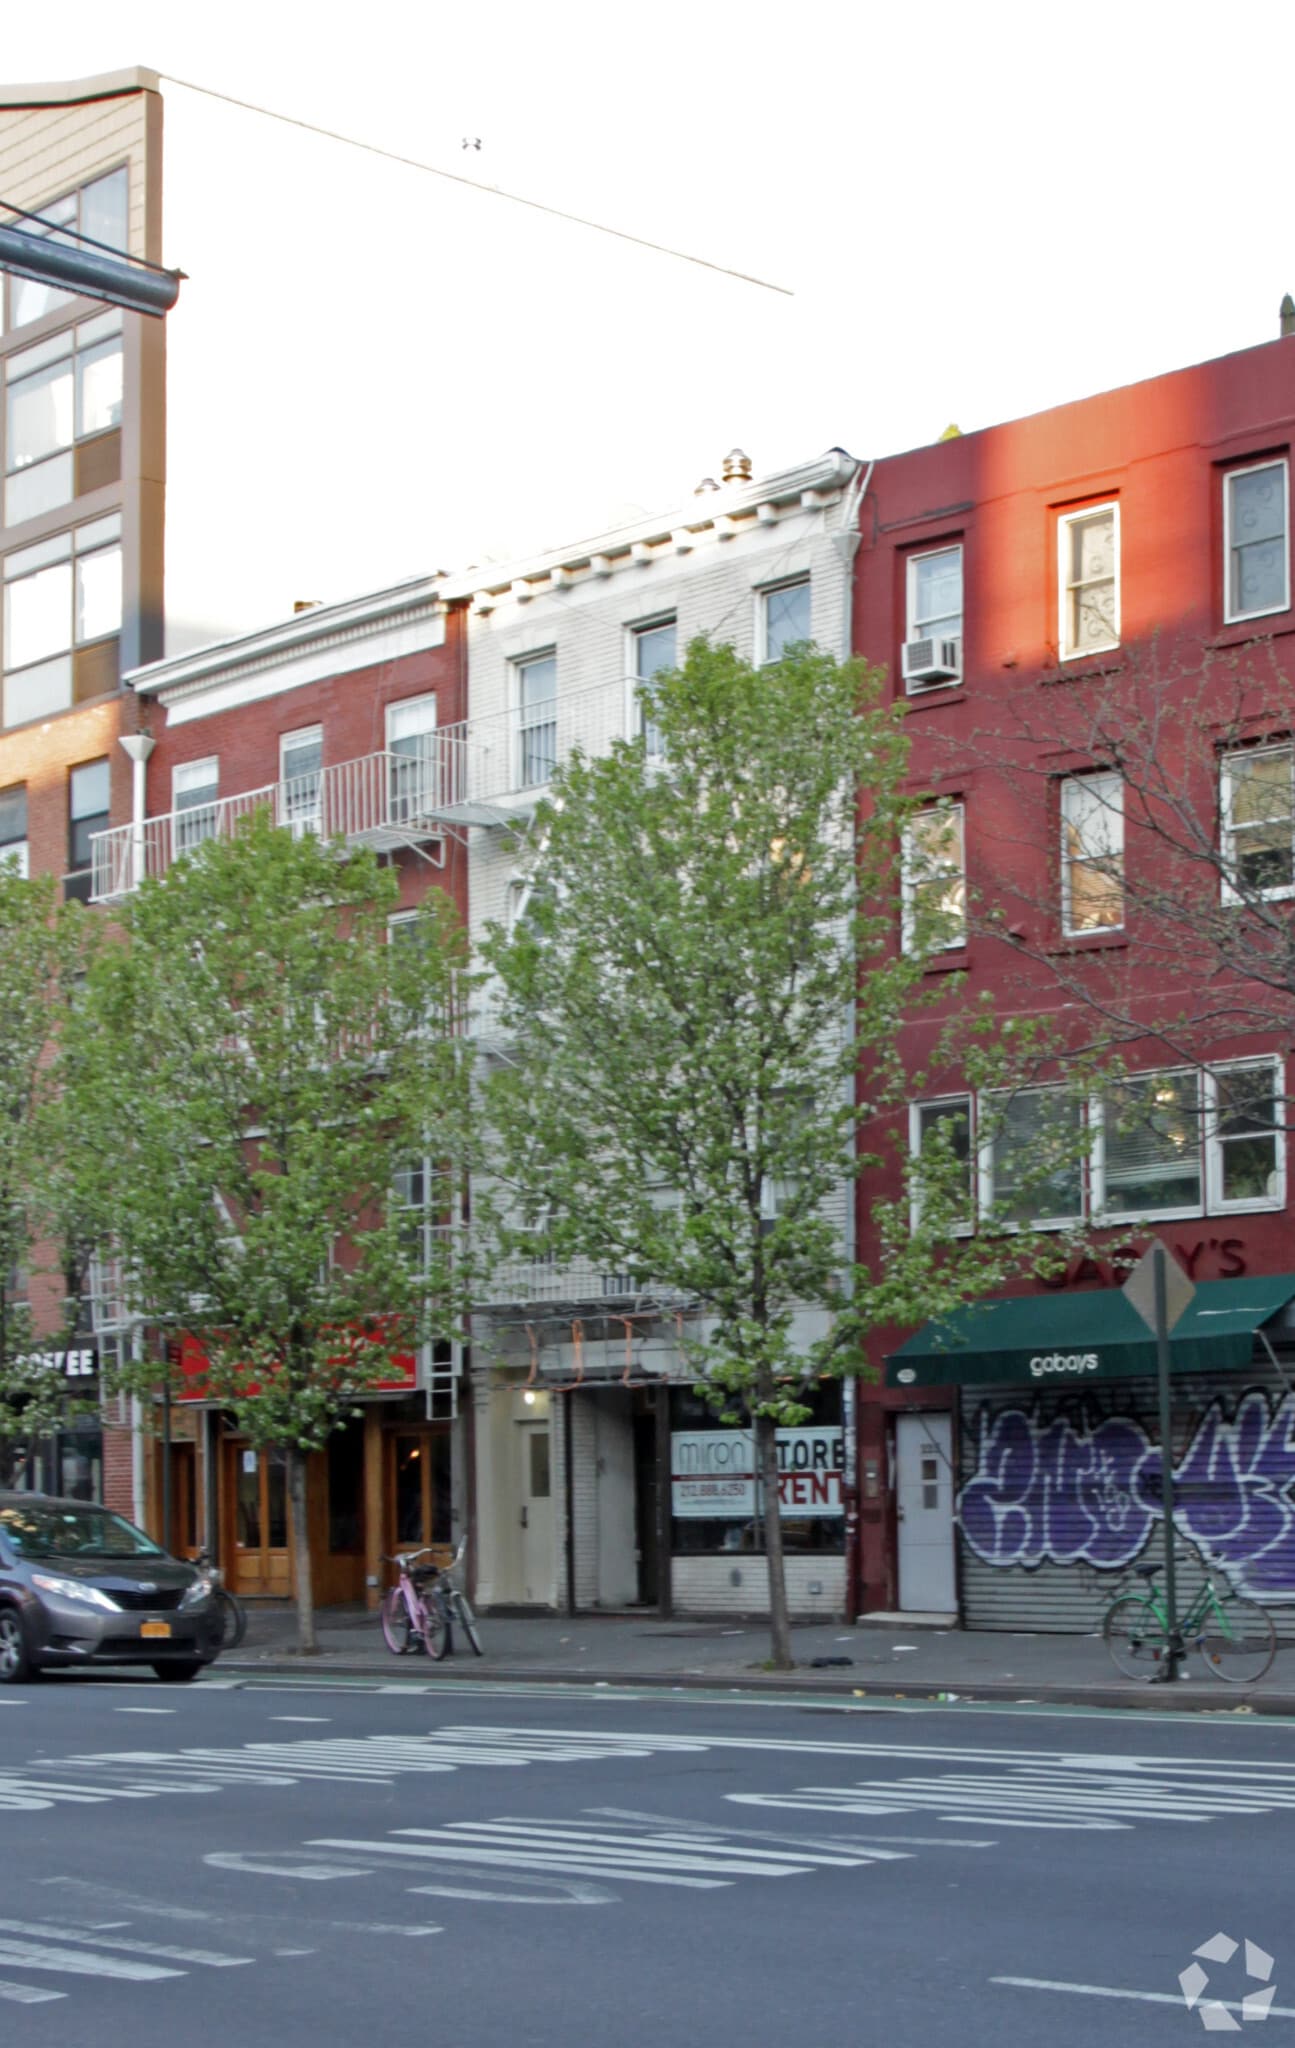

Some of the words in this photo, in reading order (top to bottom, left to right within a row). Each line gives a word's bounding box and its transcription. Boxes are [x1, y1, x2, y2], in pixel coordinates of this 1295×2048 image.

[1029, 1352, 1099, 1377] gabays
[679, 1438, 746, 1465] miron
[775, 1438, 845, 1470] TORE
